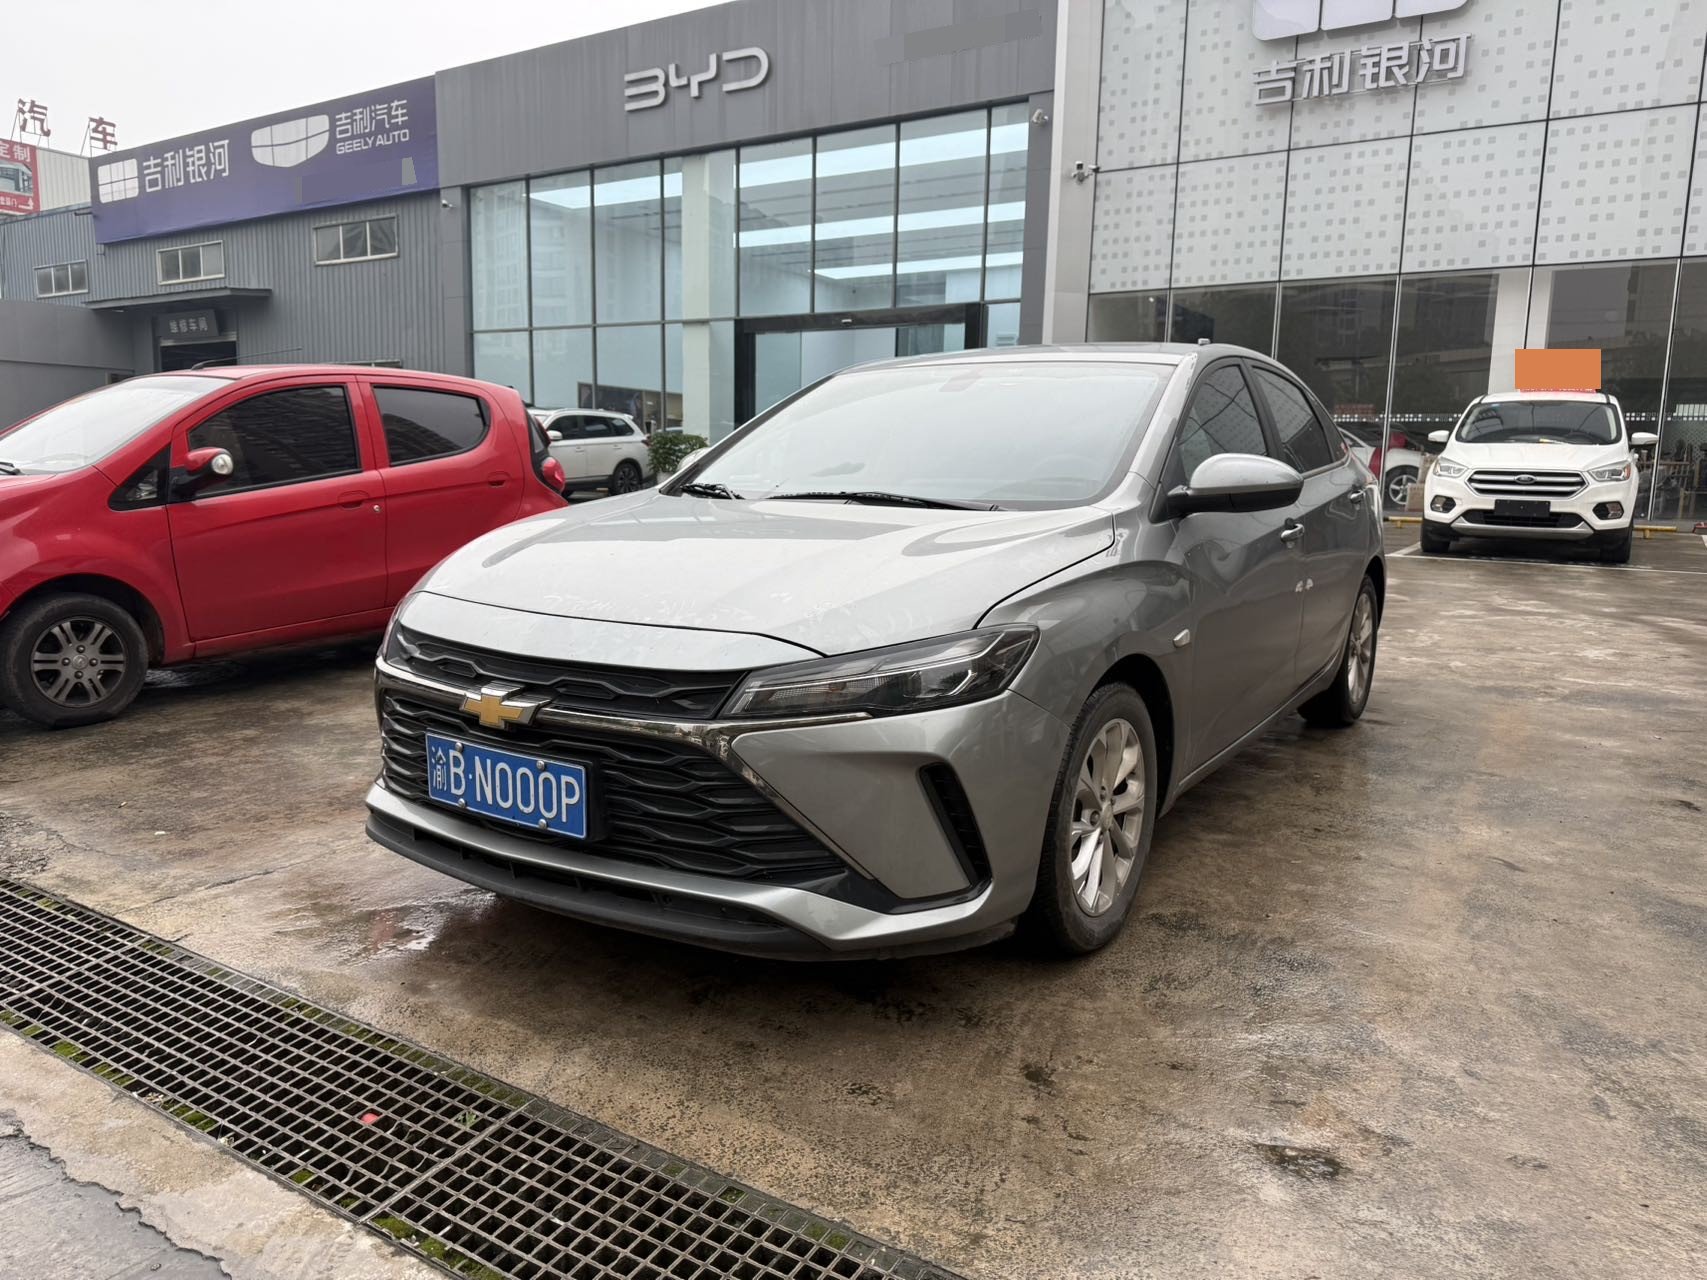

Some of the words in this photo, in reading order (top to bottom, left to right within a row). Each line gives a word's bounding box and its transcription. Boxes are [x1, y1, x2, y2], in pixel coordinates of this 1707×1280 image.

[623, 46, 771, 112] BYD
[1253, 33, 1471, 106] 吉利银河
[335, 99, 409, 139] 吉利汽车
[336, 135, 375, 155] GEELY
[375, 128, 410, 148] AUTO
[142, 139, 230, 193] 吉利银河
